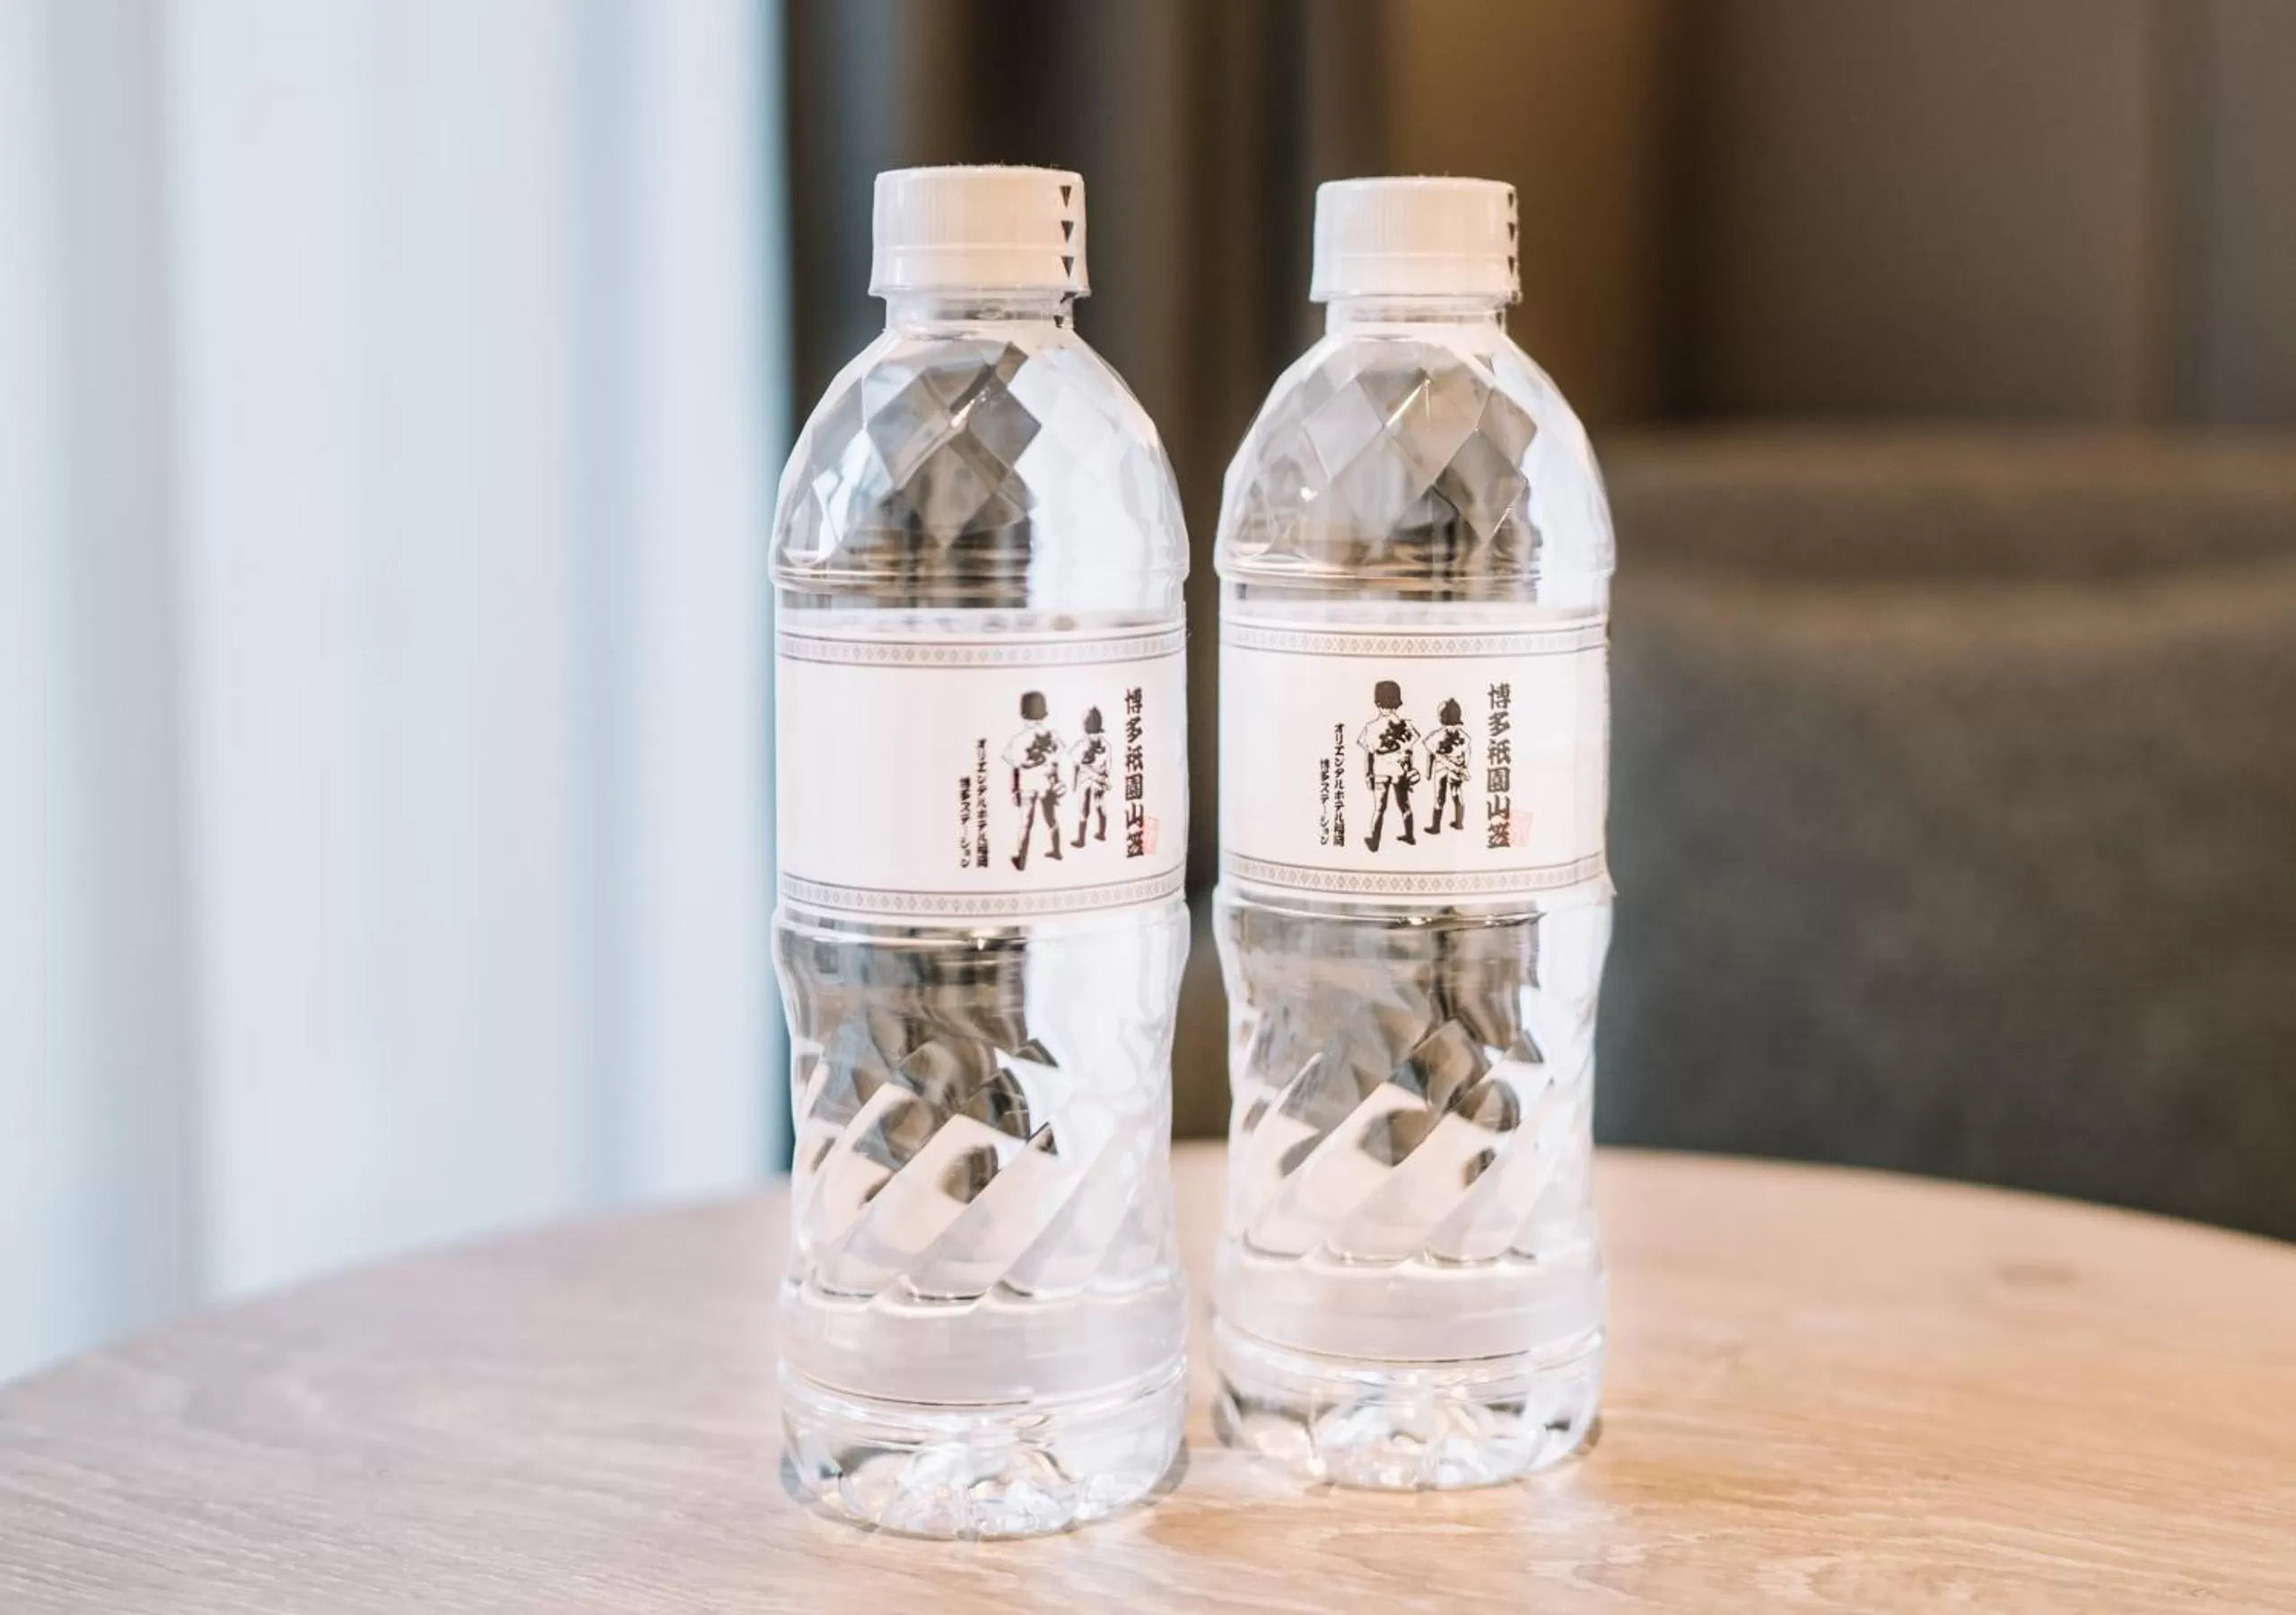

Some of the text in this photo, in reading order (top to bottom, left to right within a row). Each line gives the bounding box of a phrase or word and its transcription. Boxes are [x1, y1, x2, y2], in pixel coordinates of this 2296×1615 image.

[1486, 683, 1511, 850] 博多祇園山笠
